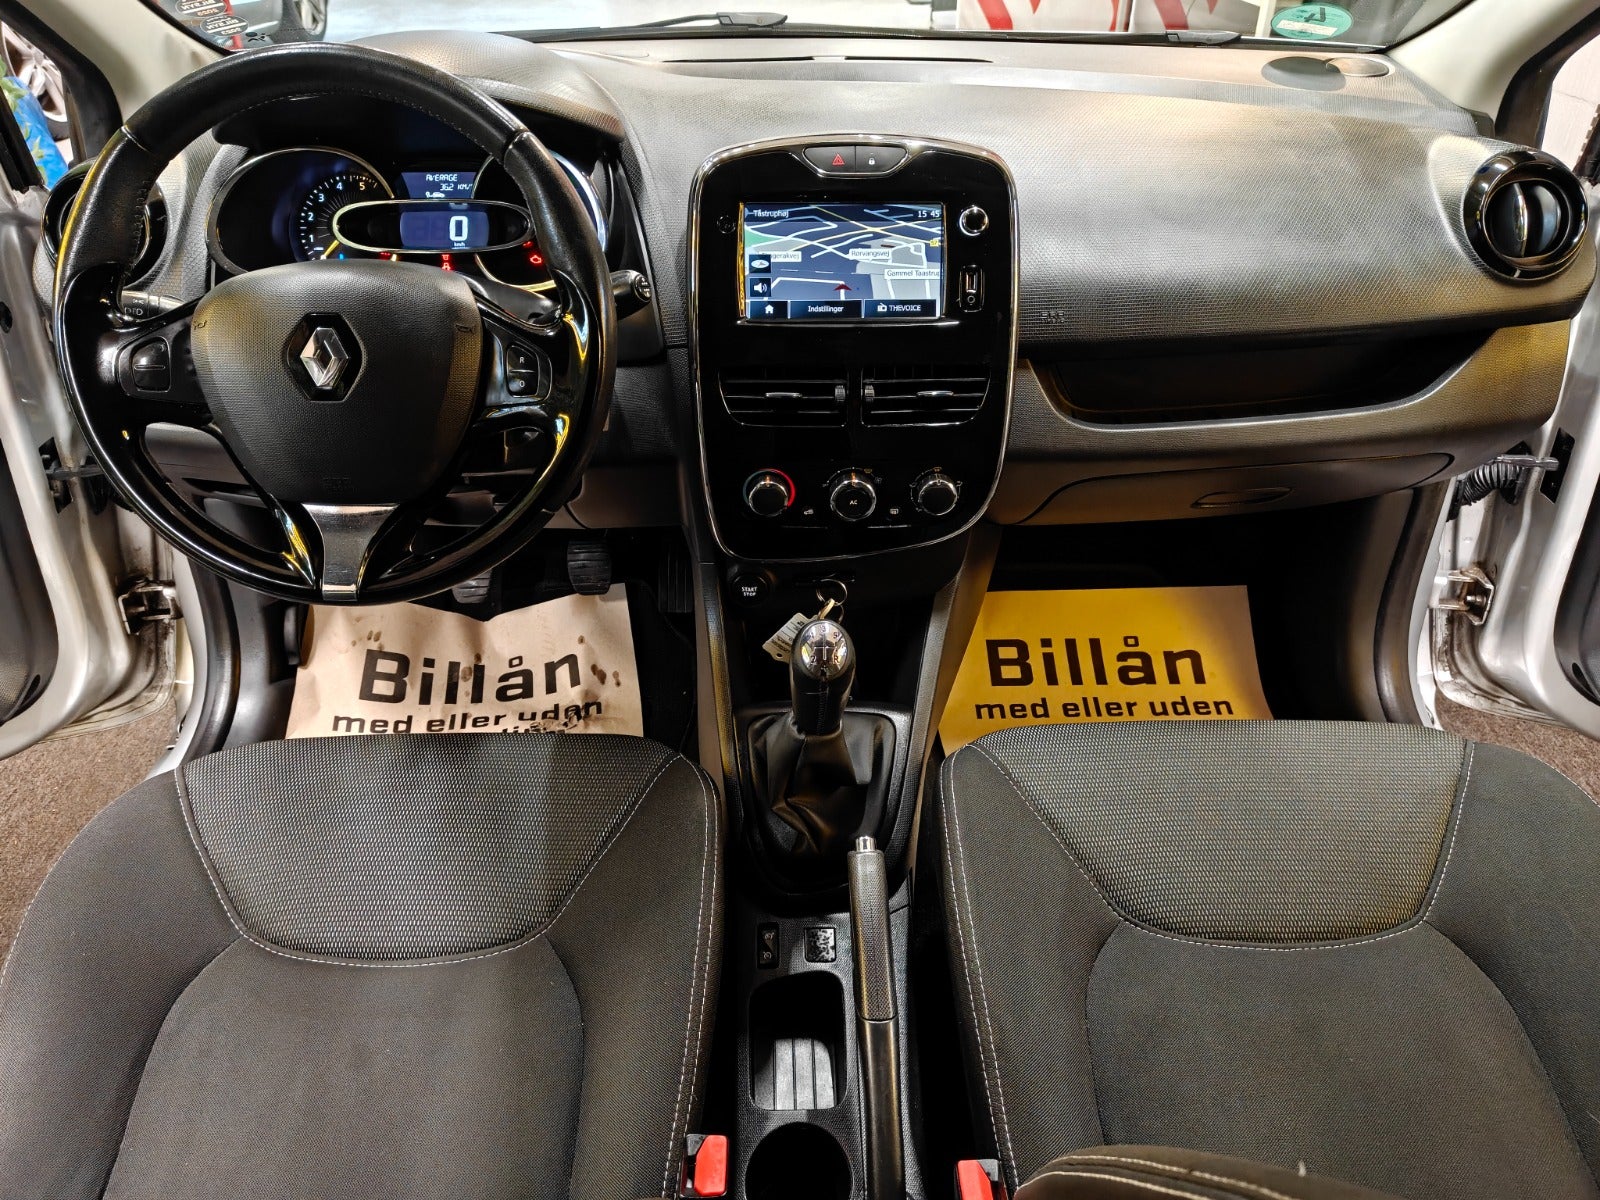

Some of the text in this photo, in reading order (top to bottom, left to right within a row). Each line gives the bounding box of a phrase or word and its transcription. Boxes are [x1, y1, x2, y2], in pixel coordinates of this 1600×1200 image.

[425, 173, 458, 181] AVERAGE
[336, 182, 343, 190] 4
[360, 182, 366, 190] 5
[318, 193, 325, 202] 3
[308, 212, 314, 221] 2
[449, 215, 468, 241] 0
[309, 234, 314, 243] 1
[807, 305, 844, 313] Indstillinger
[985, 635, 1207, 687] Billån
[358, 649, 581, 706] Billån
[975, 695, 1234, 720] med eller uden
[332, 715, 413, 735] med
[426, 713, 507, 733] eller
